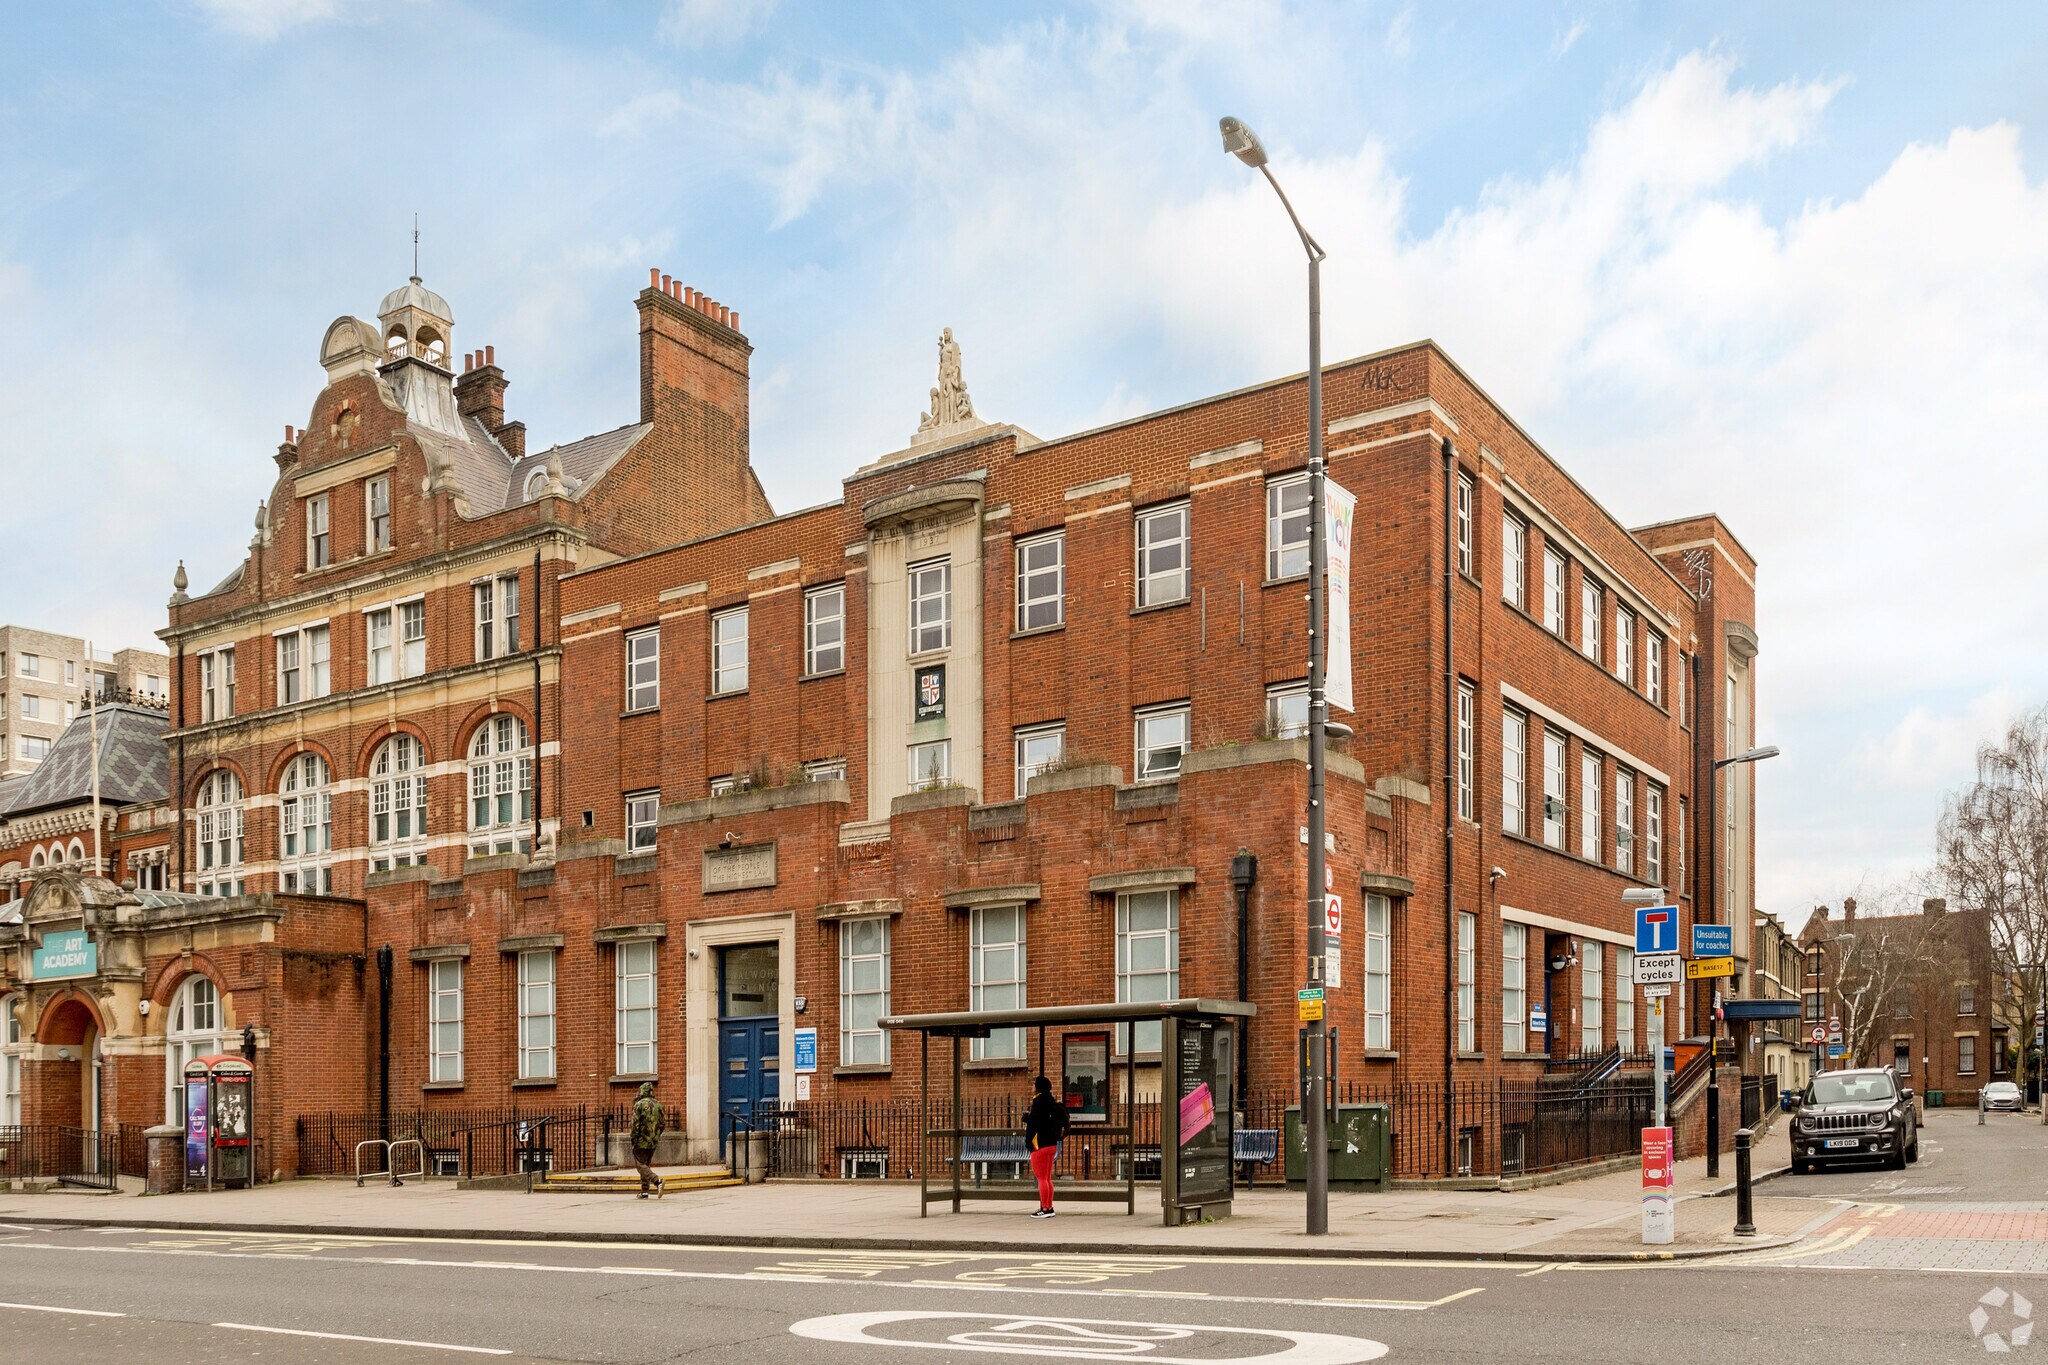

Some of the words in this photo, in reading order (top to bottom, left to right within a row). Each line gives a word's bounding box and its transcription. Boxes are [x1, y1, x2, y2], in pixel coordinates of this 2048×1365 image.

[1326, 493, 1350, 528] THANK
[1328, 513, 1350, 550] YOU
[1696, 930, 1729, 939] Unsuitable
[64, 938, 83, 952] ART
[1696, 941, 1705, 949] for
[1705, 941, 1730, 950] coaches
[43, 952, 88, 969] ACADEMY
[1640, 958, 1675, 968] Except
[1641, 970, 1673, 981] cycles
[947, 1320, 1194, 1353] 20
